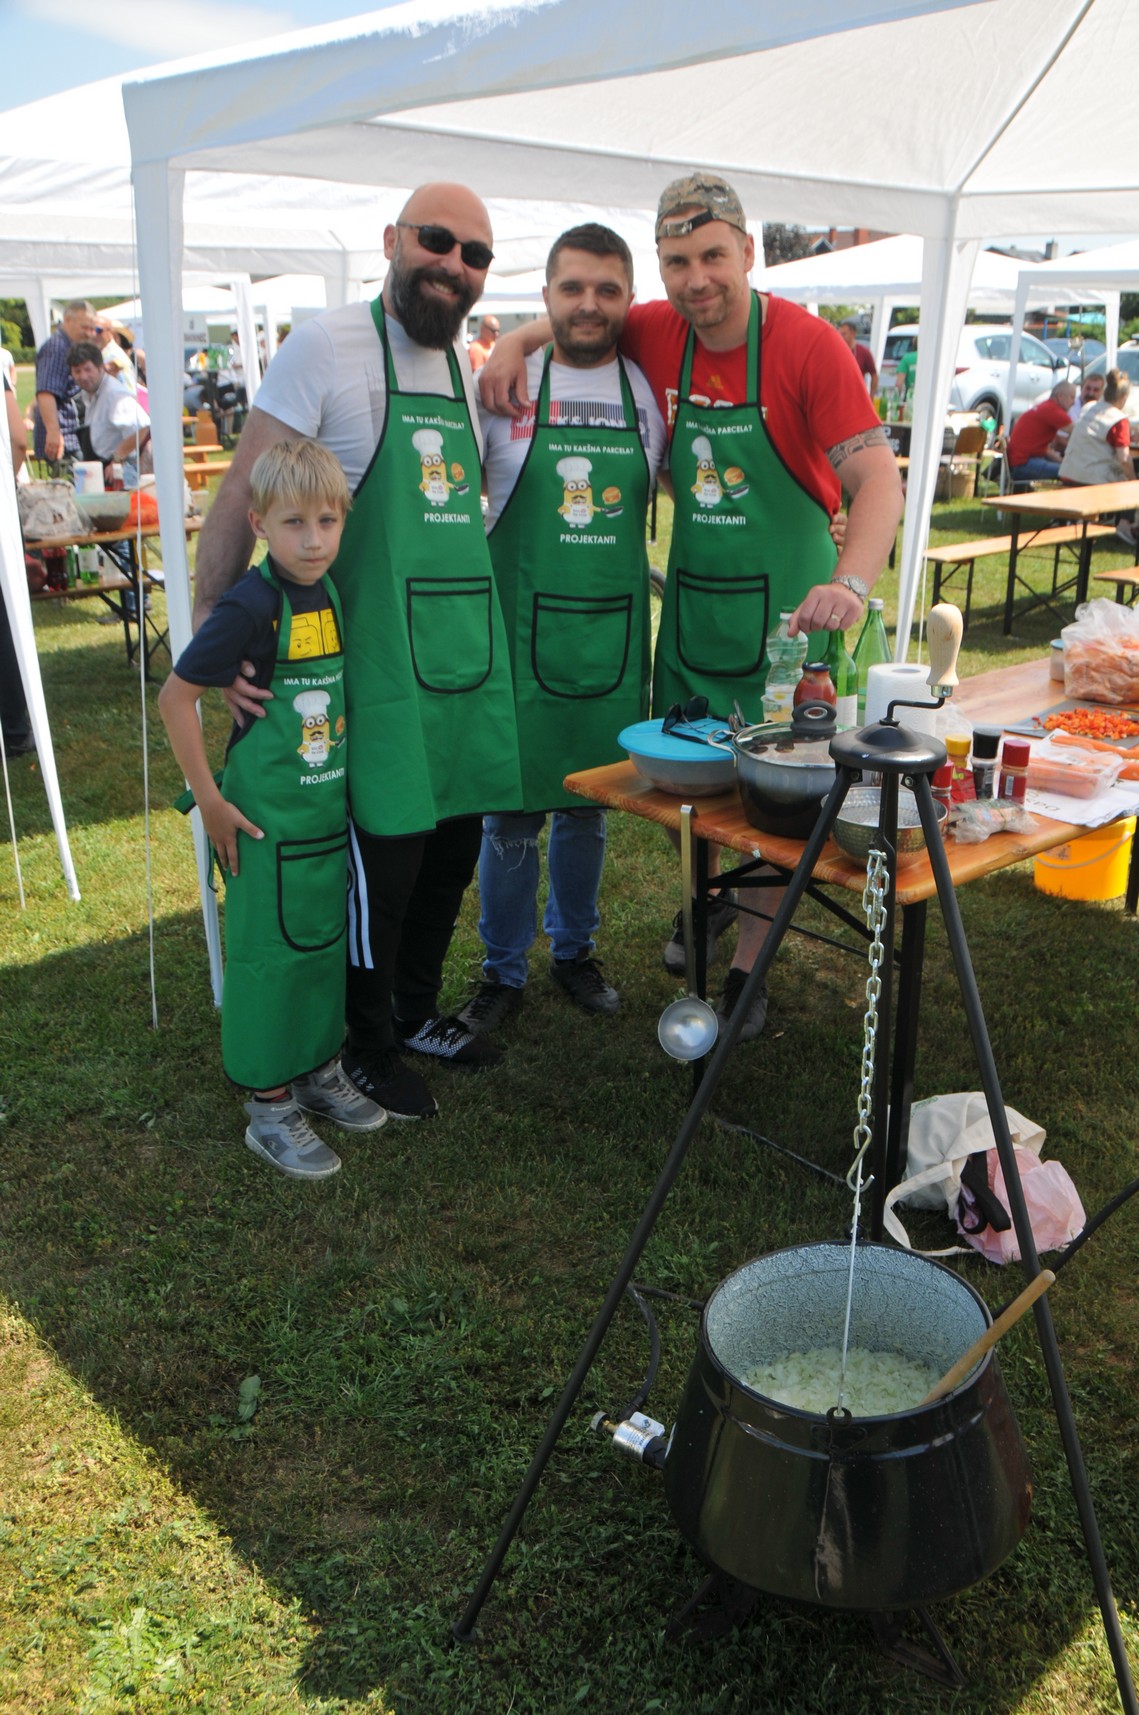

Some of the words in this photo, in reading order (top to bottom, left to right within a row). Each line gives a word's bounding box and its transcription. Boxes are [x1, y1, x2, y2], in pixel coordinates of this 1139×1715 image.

[548, 443, 562, 452] IMA
[564, 444, 572, 453] TU
[573, 443, 601, 454] KAKŠNA
[602, 446, 634, 455] PARCELA?
[692, 513, 747, 525] PROJEKTANTI
[559, 533, 617, 545] PROJEKTANTI
[283, 677, 300, 686] IMA
[301, 677, 311, 686] TU
